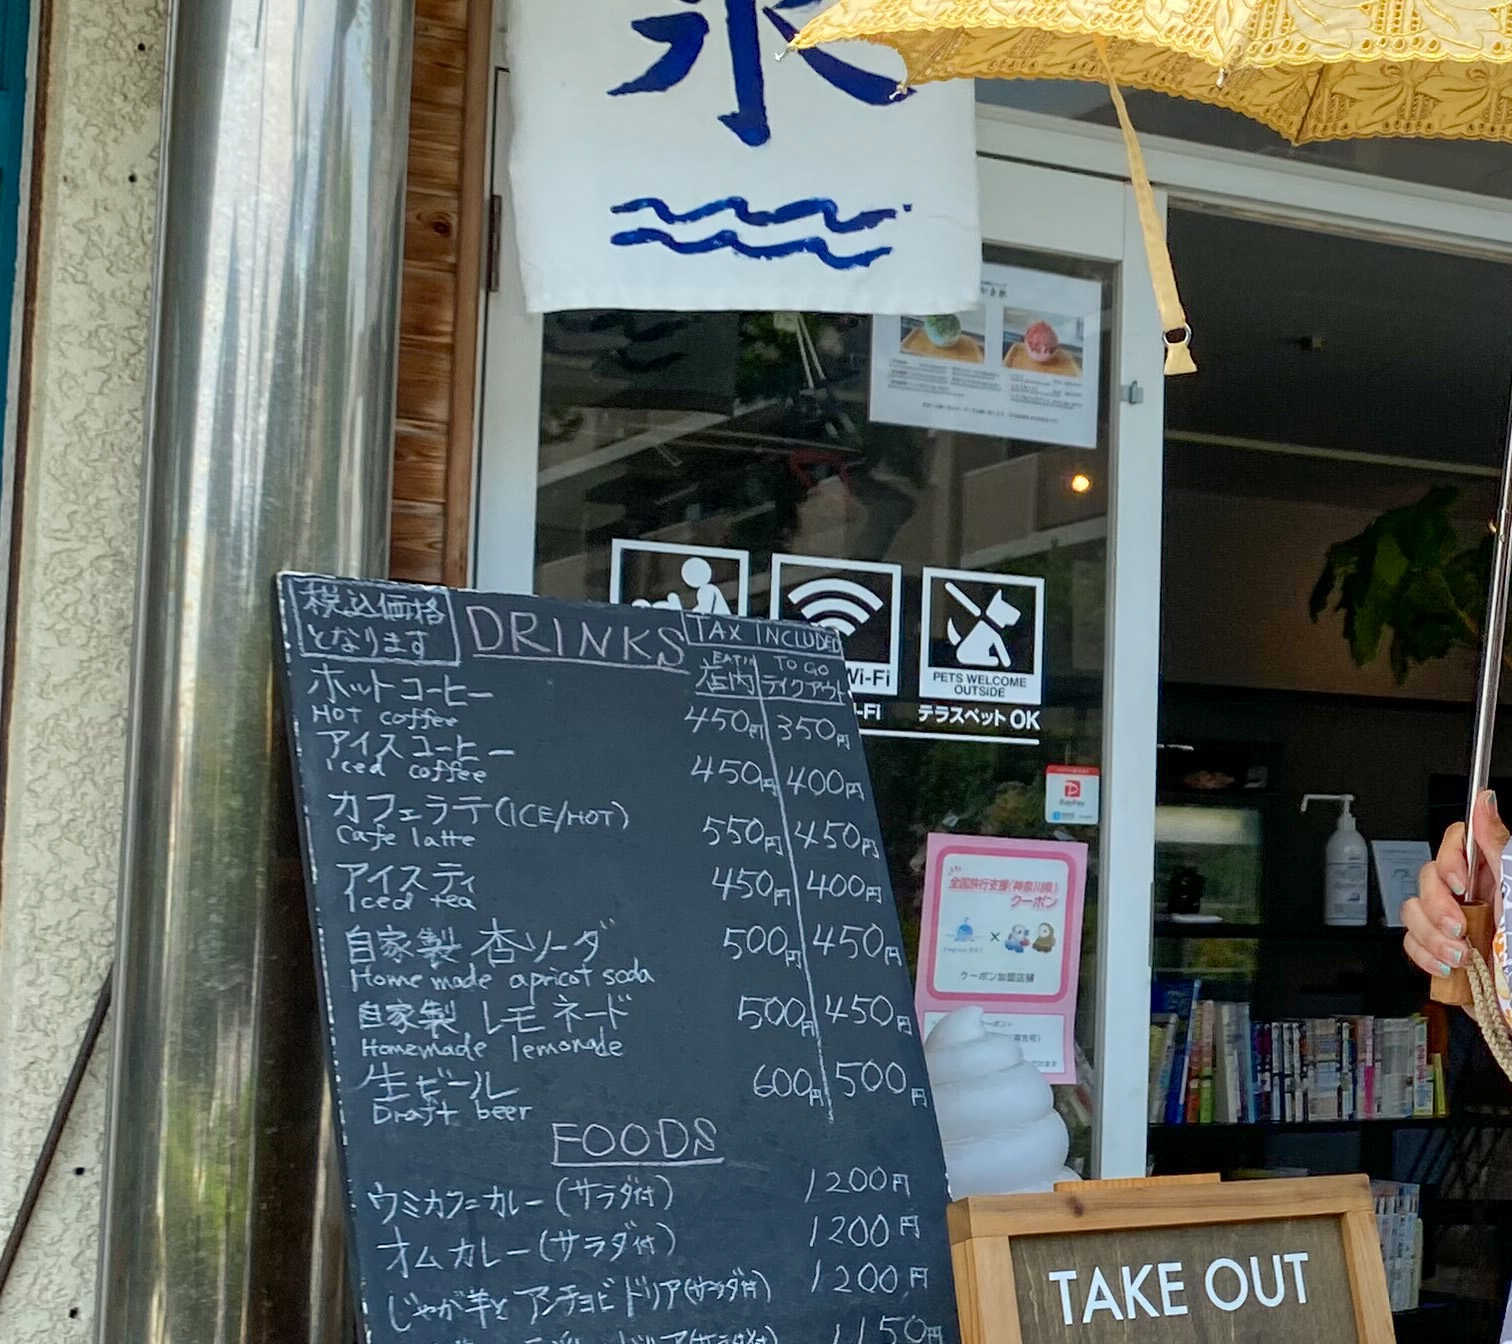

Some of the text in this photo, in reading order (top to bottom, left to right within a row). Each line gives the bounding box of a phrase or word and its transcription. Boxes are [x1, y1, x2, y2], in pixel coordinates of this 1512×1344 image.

[299, 581, 447, 625] 税込価格
[307, 625, 429, 660] となります
[466, 605, 687, 667] DRINKS
[686, 612, 842, 654] TAX INCLUDED
[774, 655, 829, 676] TO GO
[933, 671, 1027, 688] PETS WELCOME
[379, 706, 459, 731] coffee
[408, 759, 488, 783] coffee
[412, 827, 476, 848] latte
[430, 892, 478, 911] tea
[1011, 894, 1060, 909] クーポン
[509, 963, 594, 1006] apricot
[602, 957, 656, 986] soda
[512, 1026, 625, 1063] lemonade
[372, 1099, 533, 1126] Draft beer
[551, 1117, 718, 1163] FOODS
[1048, 1260, 1189, 1325] TAKE
[1204, 1252, 1310, 1312] OUT
